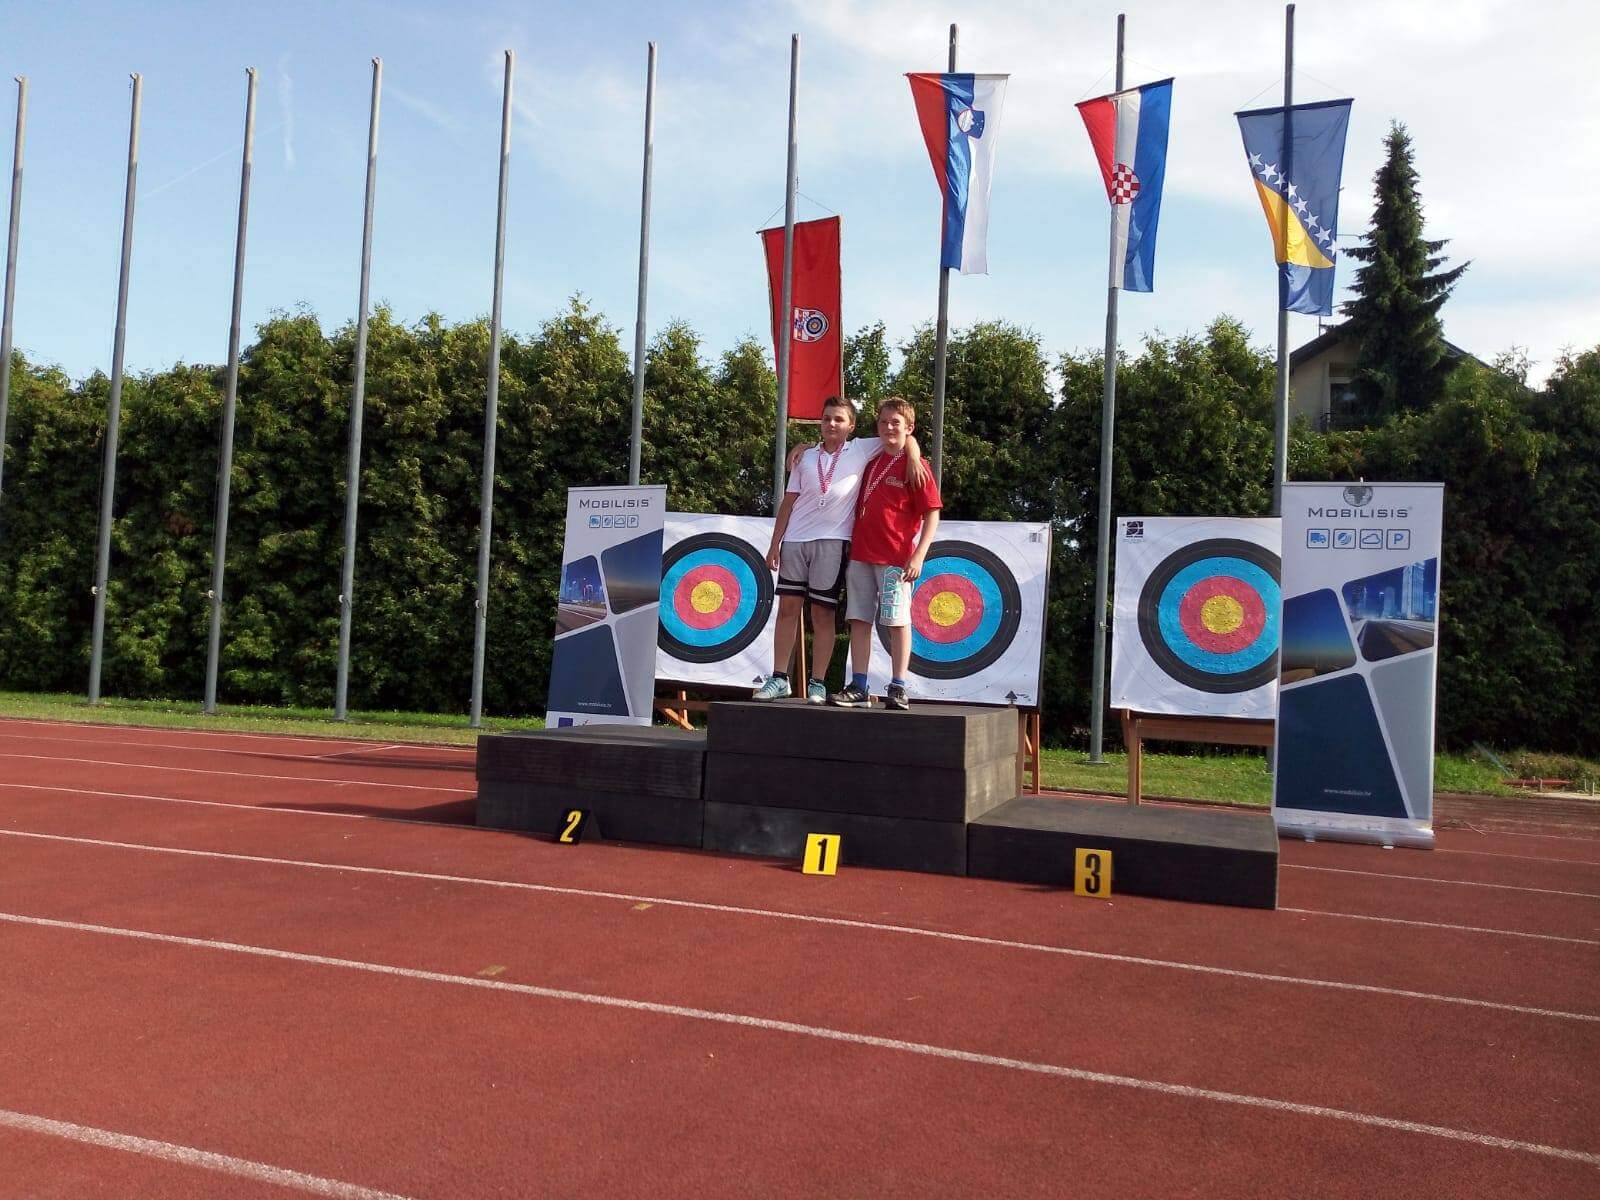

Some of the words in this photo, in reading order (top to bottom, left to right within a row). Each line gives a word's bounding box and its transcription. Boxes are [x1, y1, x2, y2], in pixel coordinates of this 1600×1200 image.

[579, 499, 649, 509] MOBILISIS
[1308, 507, 1408, 518] MOBILISIS
[1393, 533, 1404, 545] P
[560, 810, 582, 843] 2
[817, 838, 828, 872] 1
[1085, 853, 1101, 894] 3
